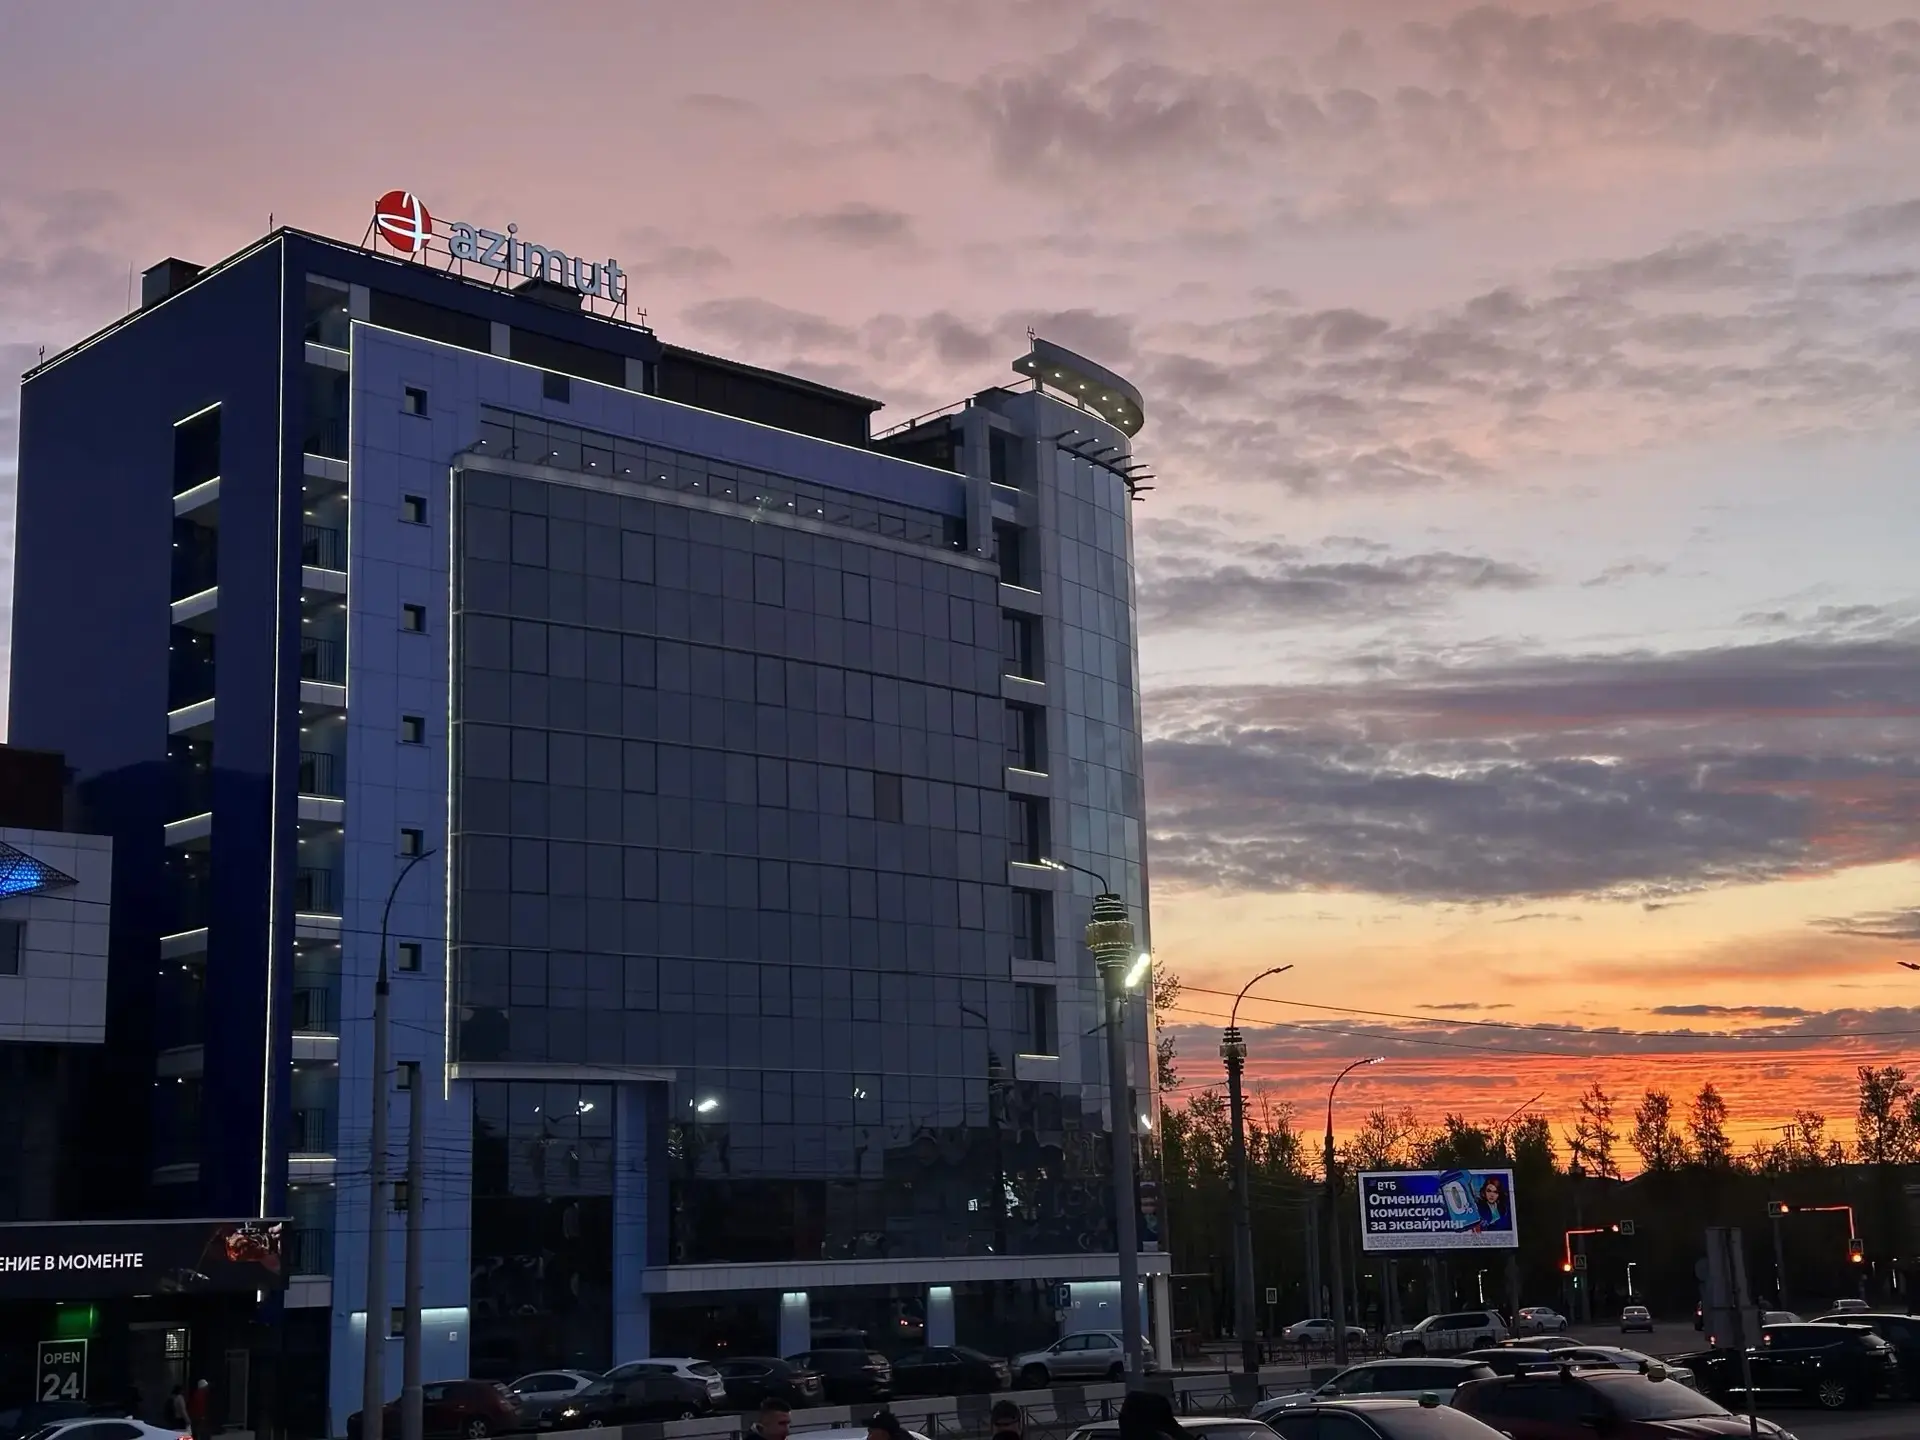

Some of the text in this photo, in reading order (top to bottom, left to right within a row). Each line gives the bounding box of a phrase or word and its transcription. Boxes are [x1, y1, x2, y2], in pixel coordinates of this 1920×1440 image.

[449, 222, 623, 303] azimut
[1369, 1193, 1444, 1205] Отменили
[1370, 1207, 1444, 1218] комиссию
[1371, 1218, 1466, 1231] за эквайринг
[44, 1255, 55, 1270] В
[58, 1253, 143, 1270] МОМЕНТЕ
[43, 1352, 80, 1365] OPEN
[43, 1372, 80, 1401] 24
